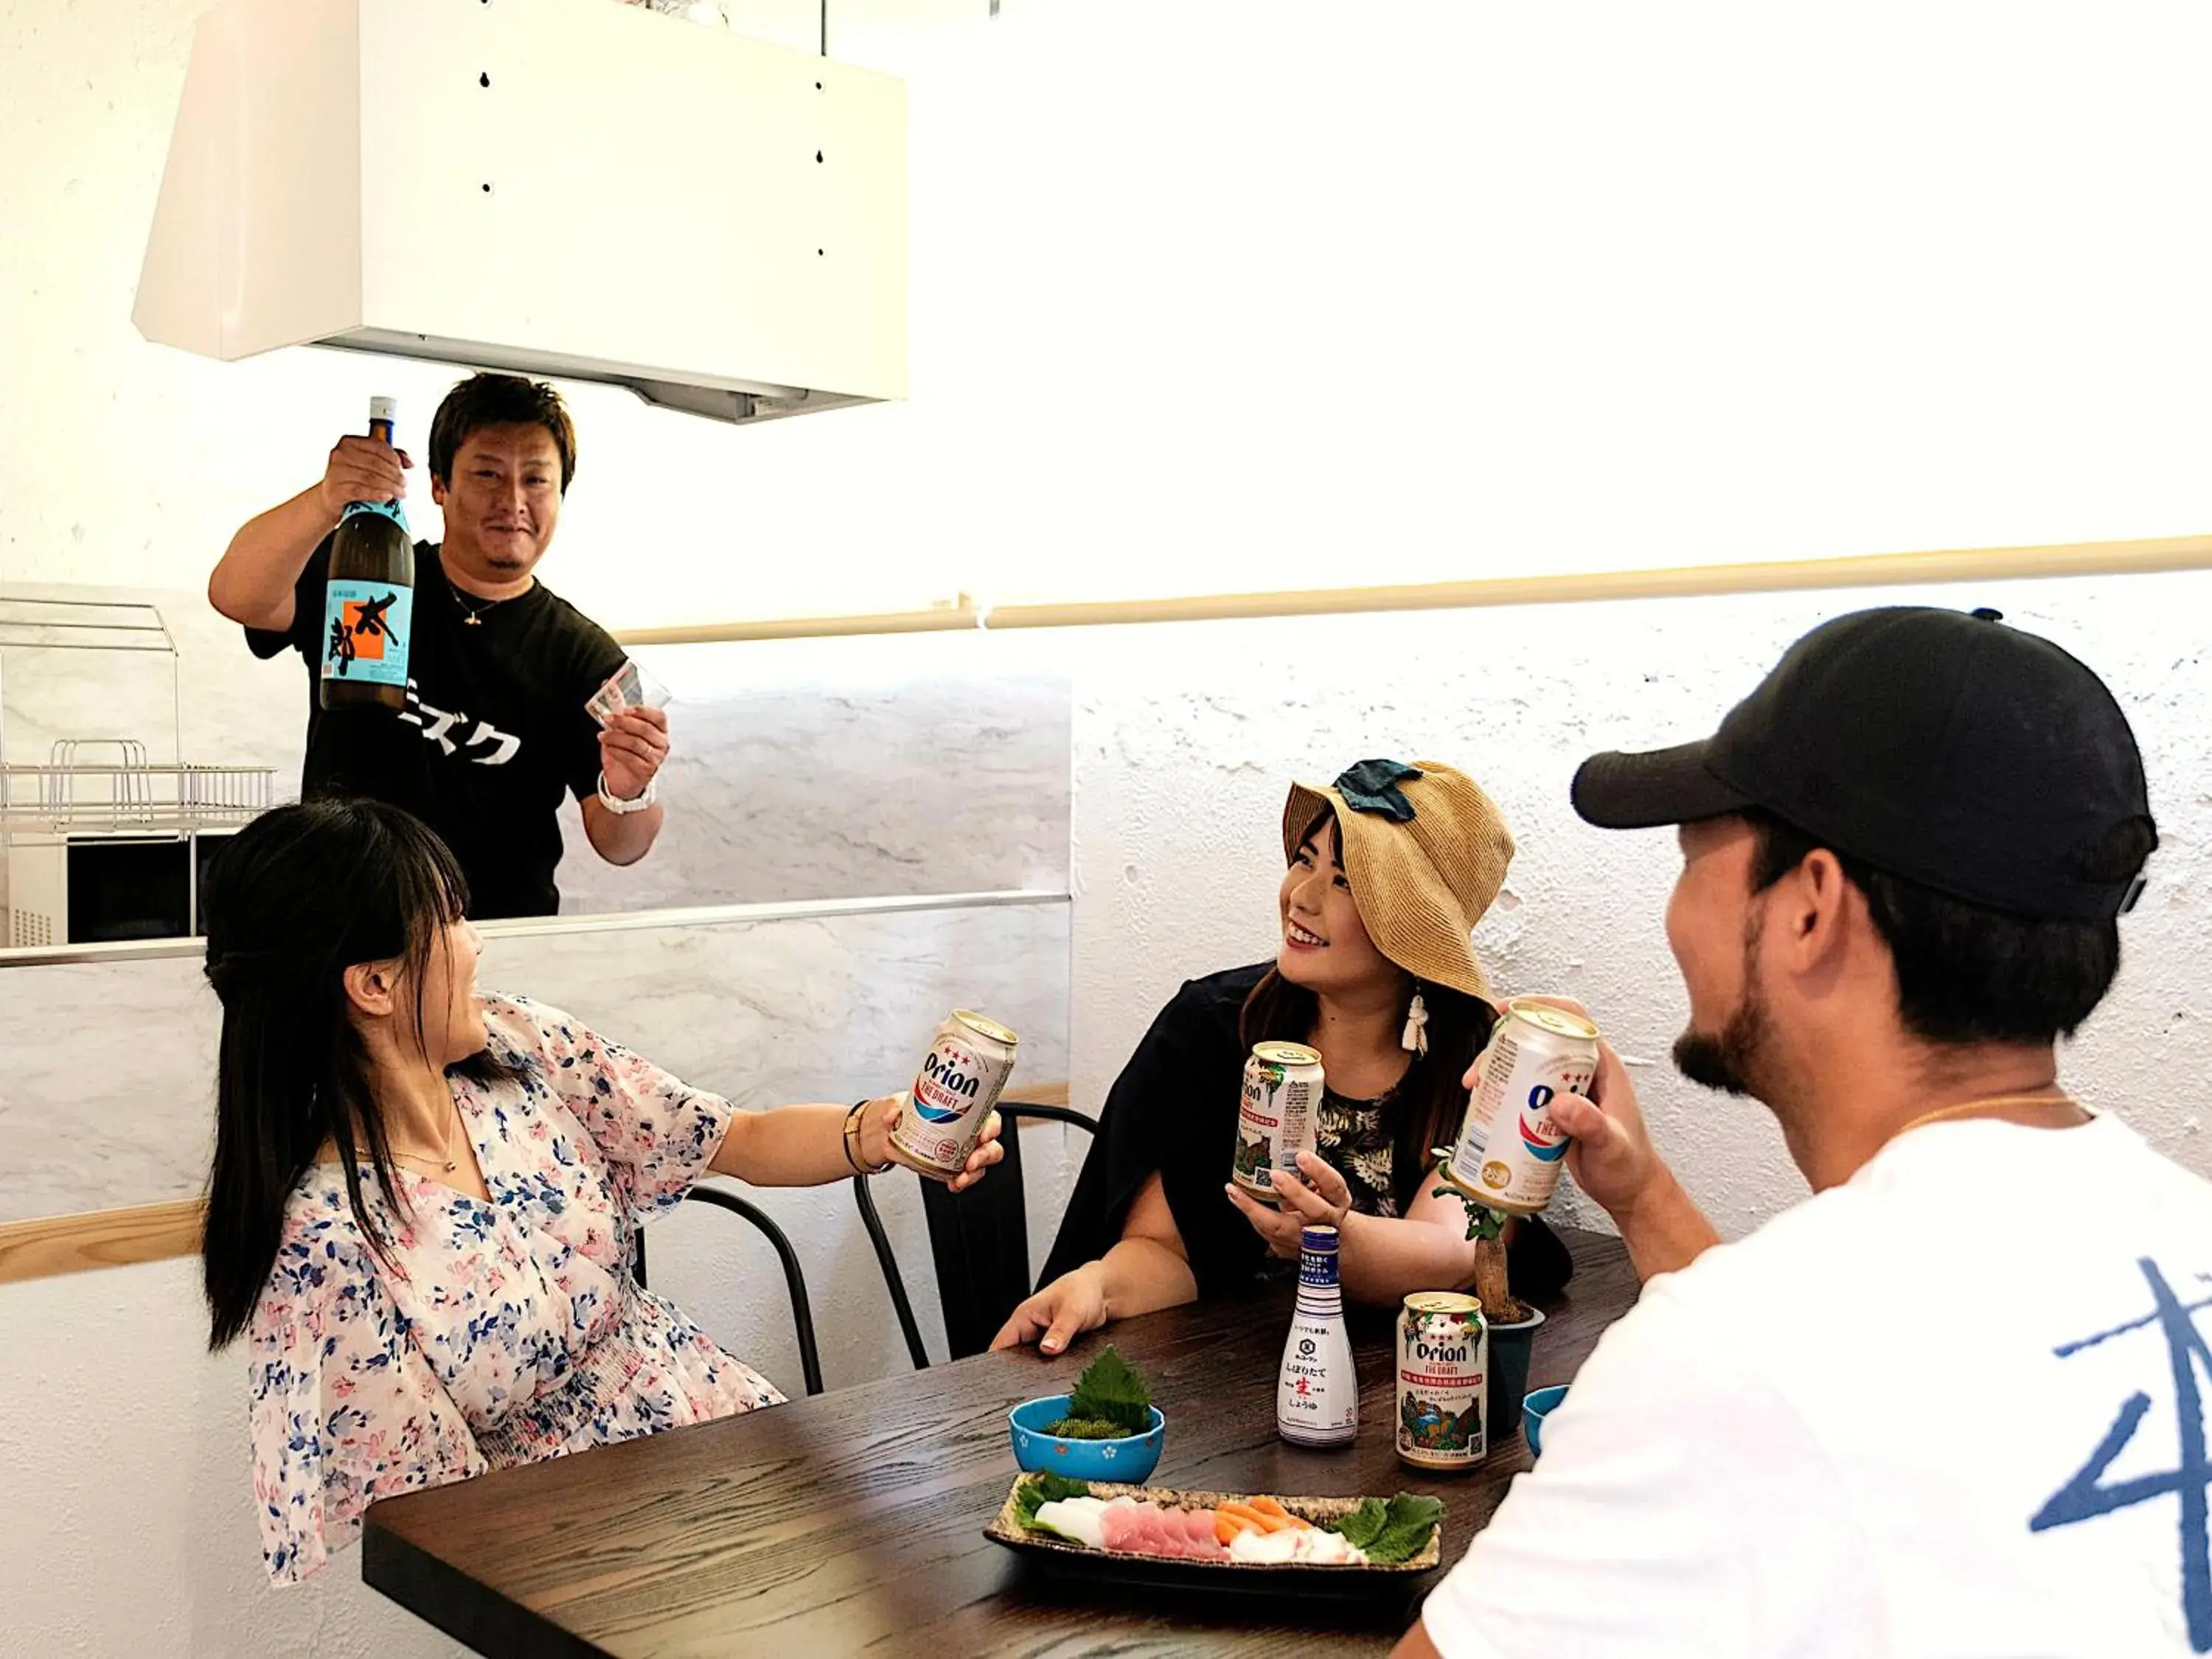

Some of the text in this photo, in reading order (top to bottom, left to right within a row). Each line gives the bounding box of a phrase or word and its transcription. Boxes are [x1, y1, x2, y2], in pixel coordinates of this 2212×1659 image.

[925, 1052, 980, 1098] Orion
[932, 1090, 959, 1109] DRAFT
[1416, 1341, 1467, 1362] Orion
[1287, 1363, 1327, 1377] しぼりたて
[1296, 1377, 1312, 1396] 生
[1289, 1399, 1318, 1410] しょうゆ
